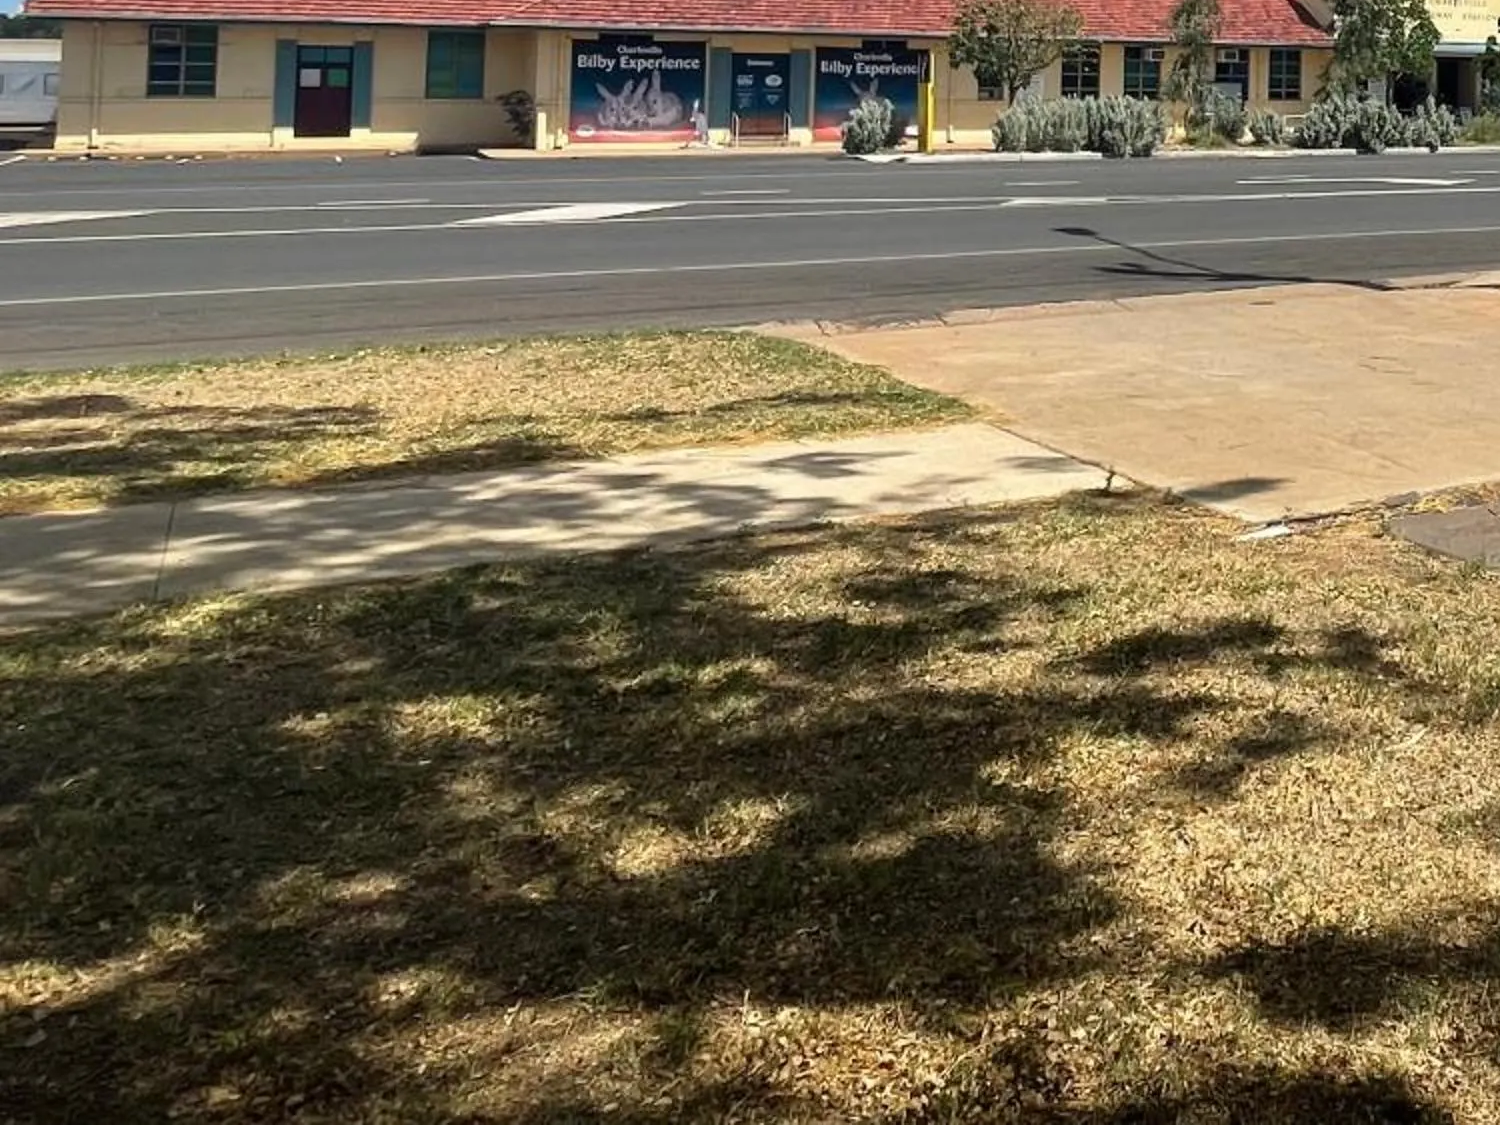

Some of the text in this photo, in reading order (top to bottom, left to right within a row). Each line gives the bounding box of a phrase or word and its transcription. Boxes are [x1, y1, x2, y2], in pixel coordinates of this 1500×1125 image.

[577, 54, 700, 72] Bilby Experience
[821, 60, 919, 77] Bilby Experienc
